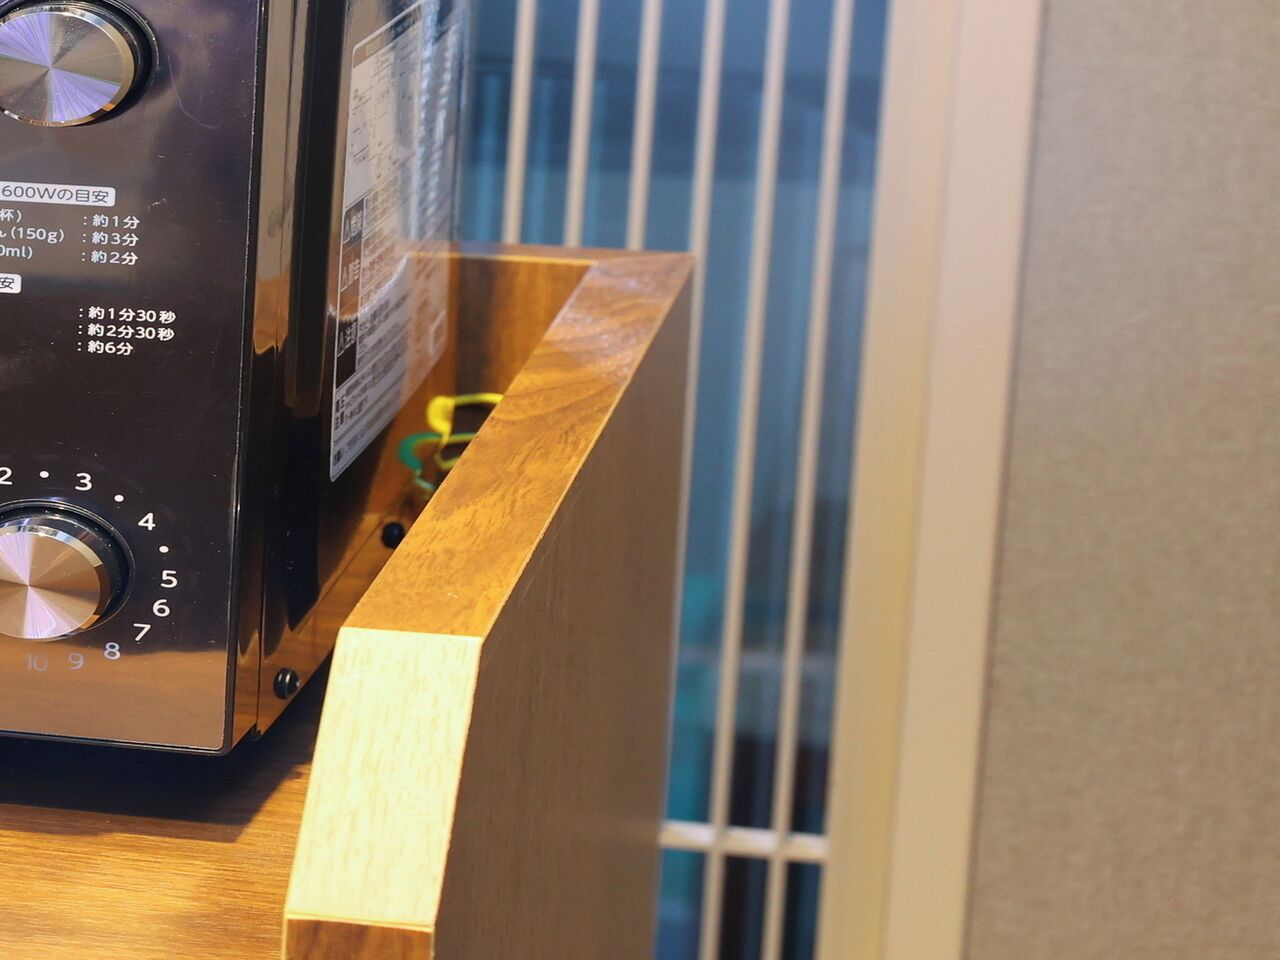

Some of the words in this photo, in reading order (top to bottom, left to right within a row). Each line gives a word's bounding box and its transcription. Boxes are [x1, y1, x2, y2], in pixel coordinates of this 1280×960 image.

[75, 473, 92, 490] 3
[138, 513, 155, 530] 4
[161, 570, 177, 587] 5
[153, 599, 170, 616] 6
[134, 624, 150, 640] 7
[103, 642, 121, 660] 8
[68, 652, 84, 670] 9
